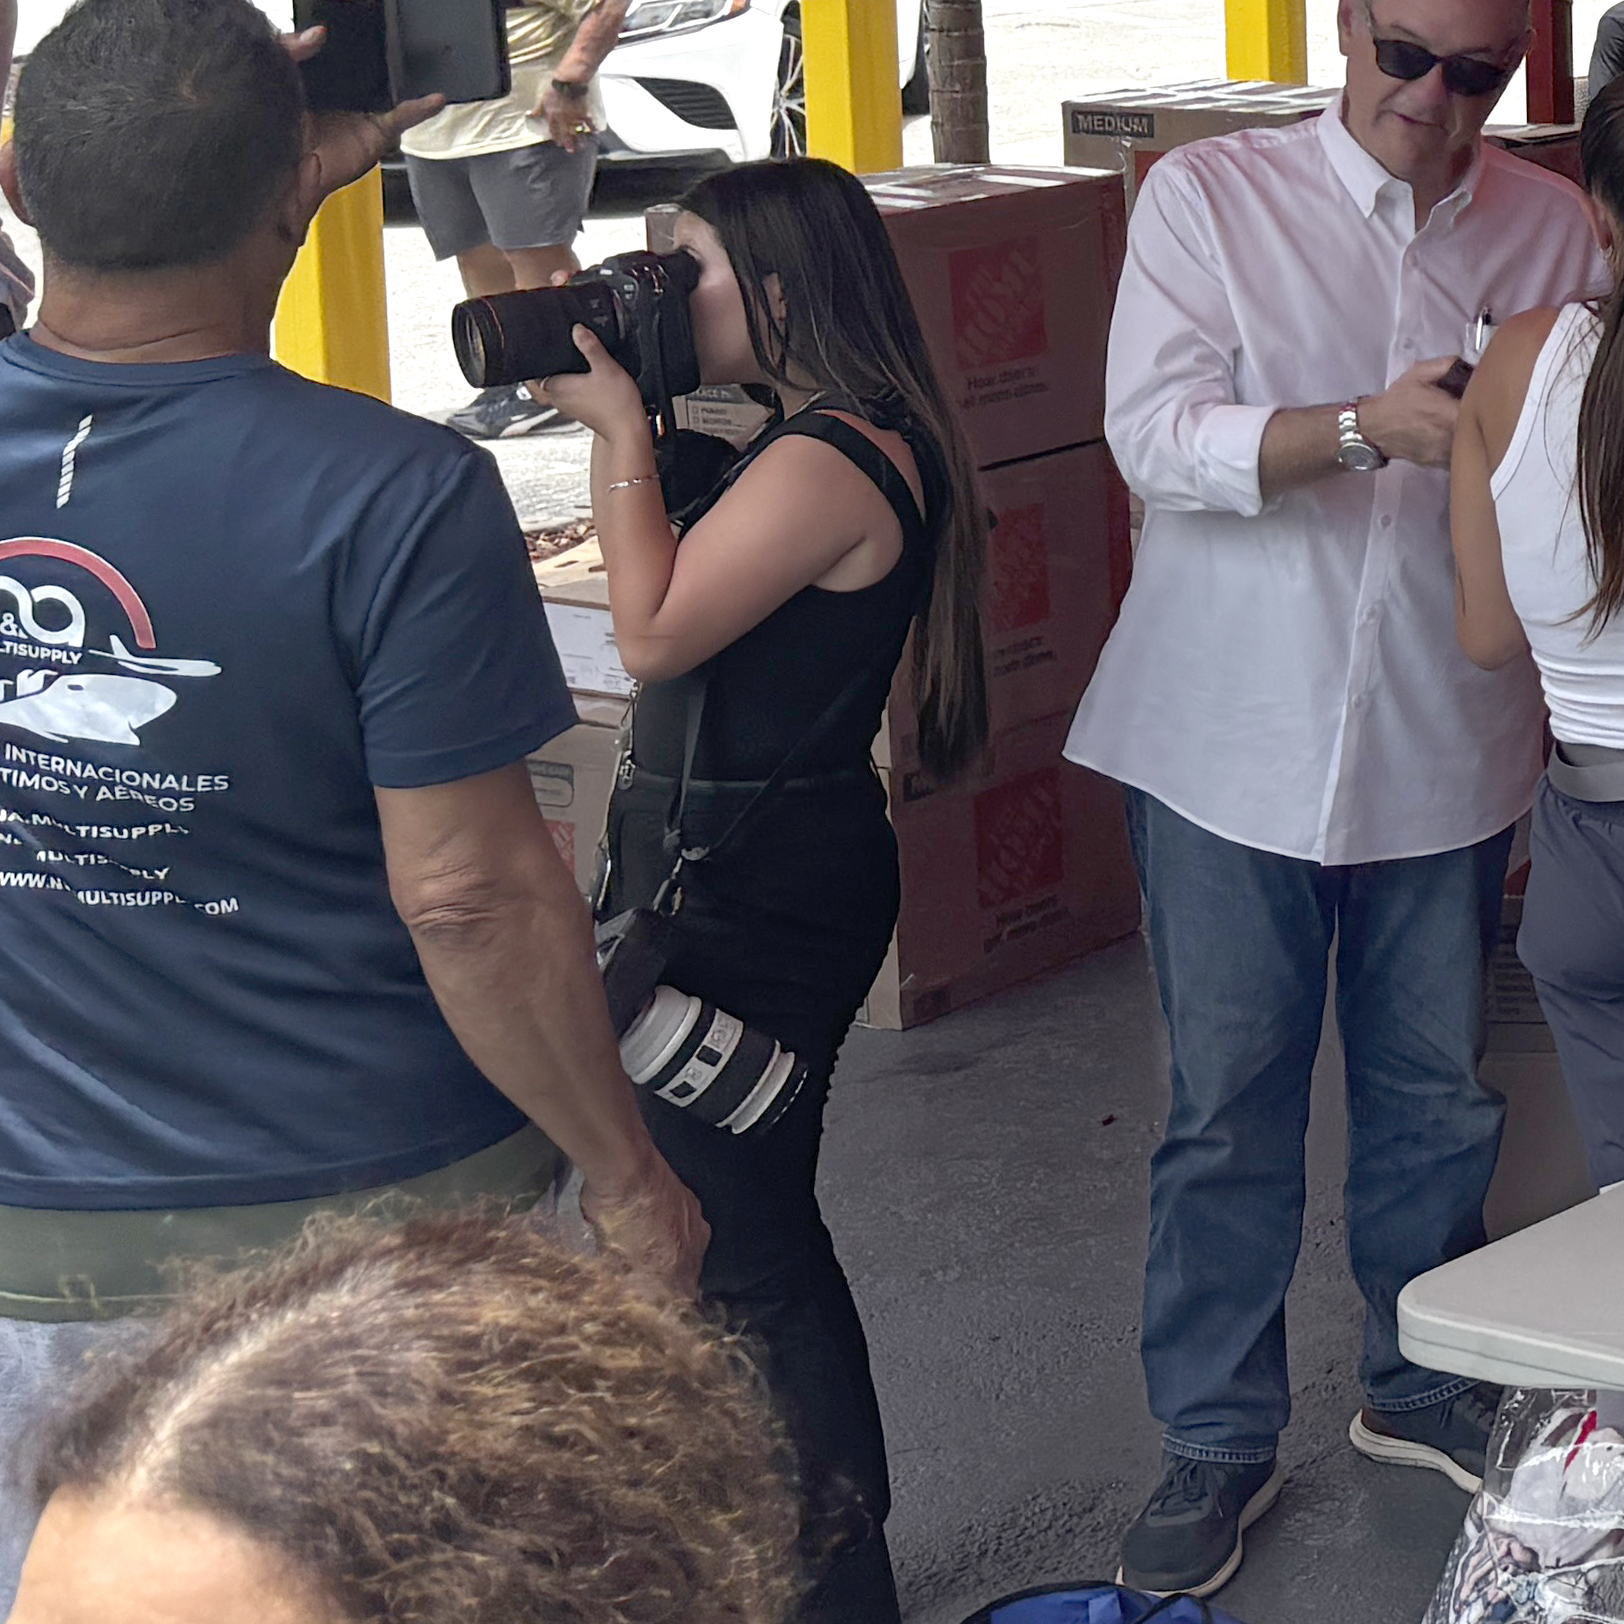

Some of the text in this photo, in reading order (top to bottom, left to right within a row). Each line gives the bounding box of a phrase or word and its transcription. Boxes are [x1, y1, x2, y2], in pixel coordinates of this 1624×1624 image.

[1077, 114, 1150, 135] MEDIUM
[4, 742, 230, 793] INTERNACIONALES
[74, 784, 90, 800] Y
